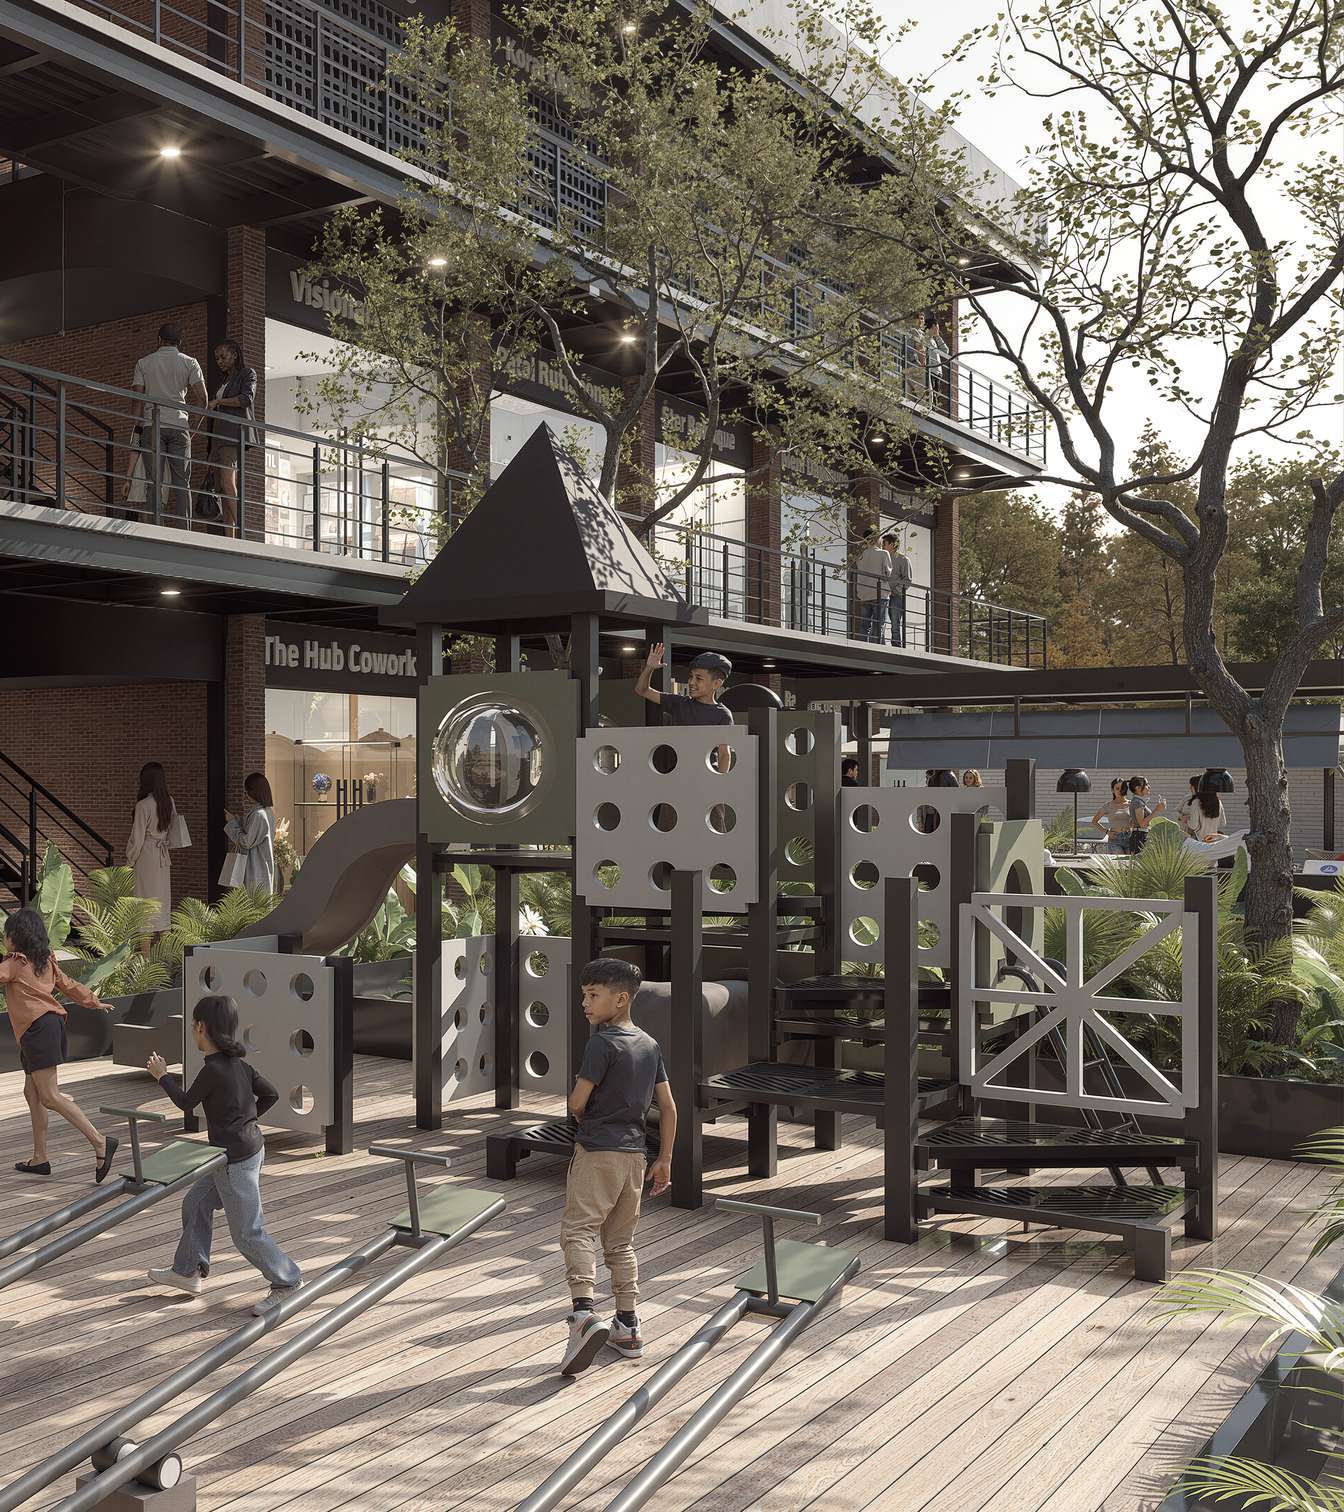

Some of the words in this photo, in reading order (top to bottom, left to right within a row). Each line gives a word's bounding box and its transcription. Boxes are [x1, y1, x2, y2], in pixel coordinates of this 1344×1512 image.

[264, 635, 300, 668] The
[303, 640, 345, 671] Hub
[348, 644, 417, 677] Cowork
